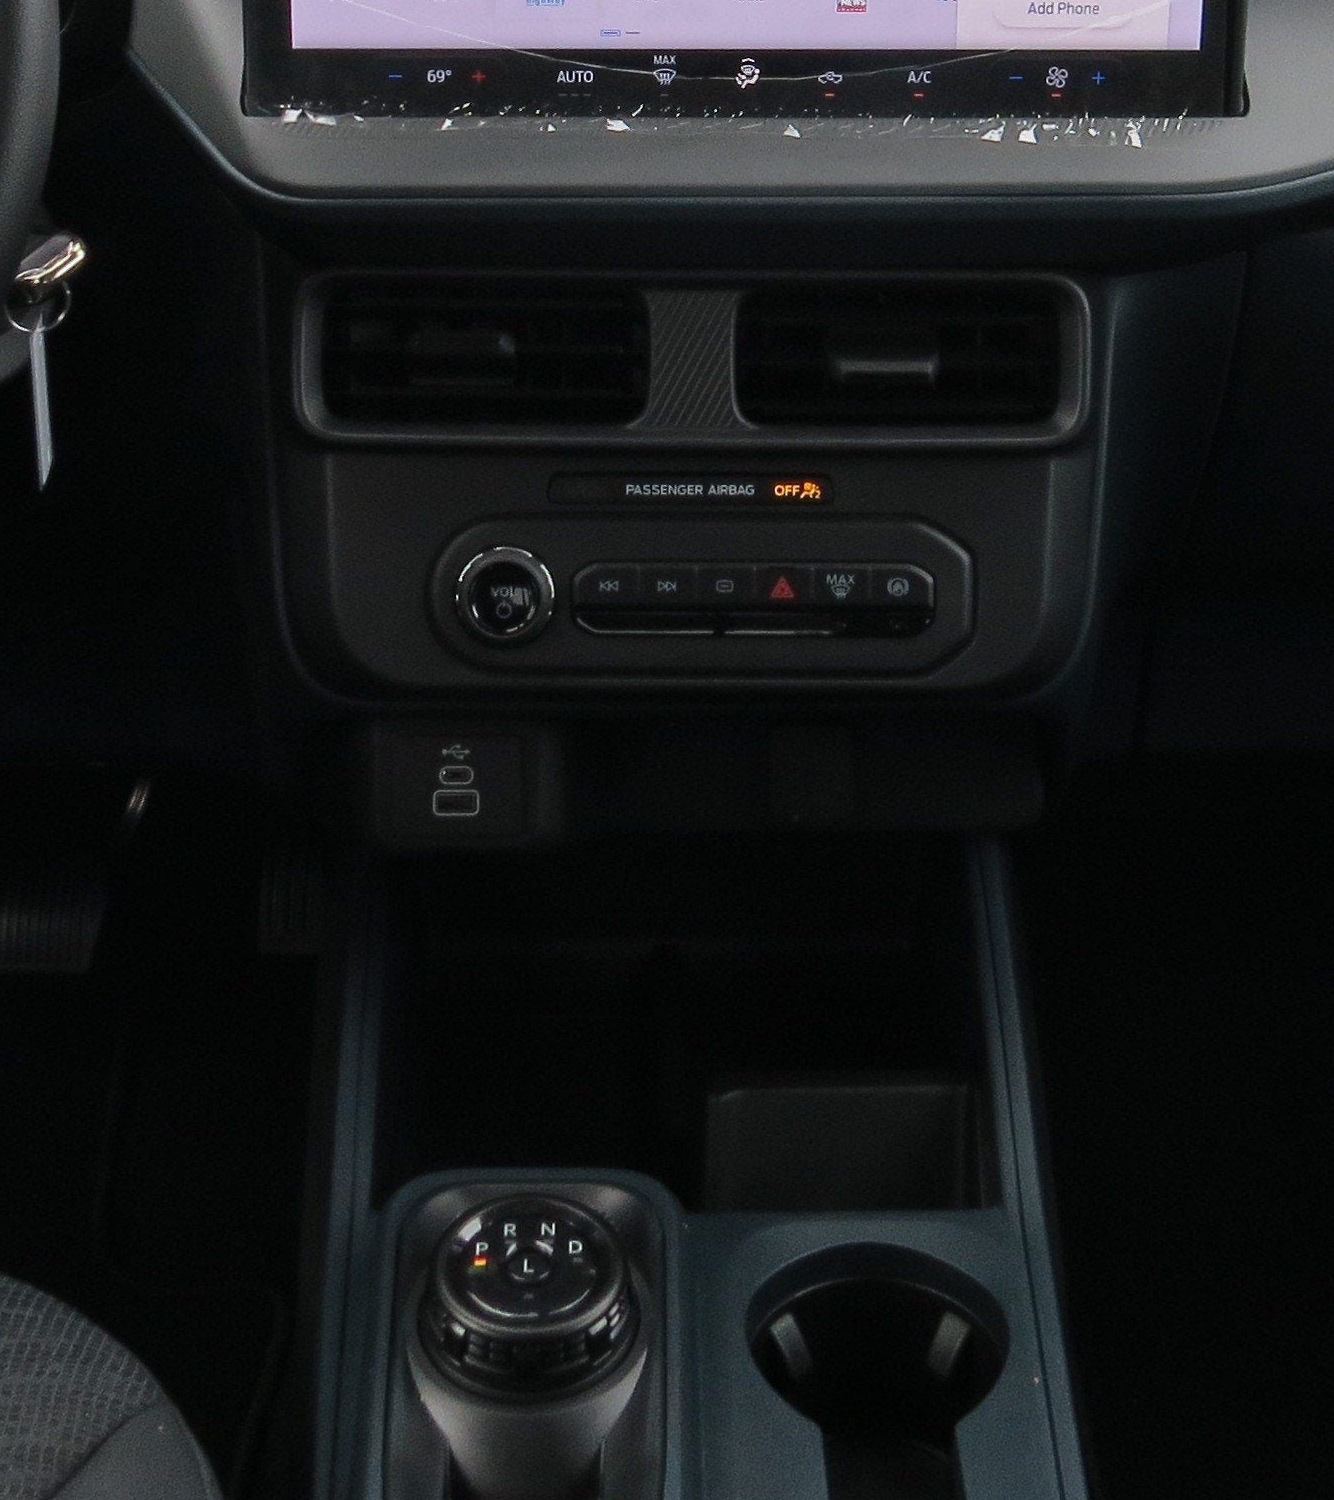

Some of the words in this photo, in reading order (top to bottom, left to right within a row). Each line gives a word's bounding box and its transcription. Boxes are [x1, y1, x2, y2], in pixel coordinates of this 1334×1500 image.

[1027, 1, 1054, 15] Add
[1057, 1, 1100, 15] Phone
[652, 55, 677, 66] MAX
[427, 69, 453, 83] 69°
[556, 70, 594, 83] AUTO
[907, 70, 932, 84] A/C
[625, 483, 704, 496] PASSENGER
[707, 483, 756, 496] AIRBAG
[774, 484, 800, 498] OFF
[826, 573, 856, 586] MAX
[503, 1223, 517, 1237] R
[540, 1222, 556, 1236] N
[475, 1241, 489, 1256] P
[568, 1240, 583, 1255] D
[522, 1258, 534, 1273] L
